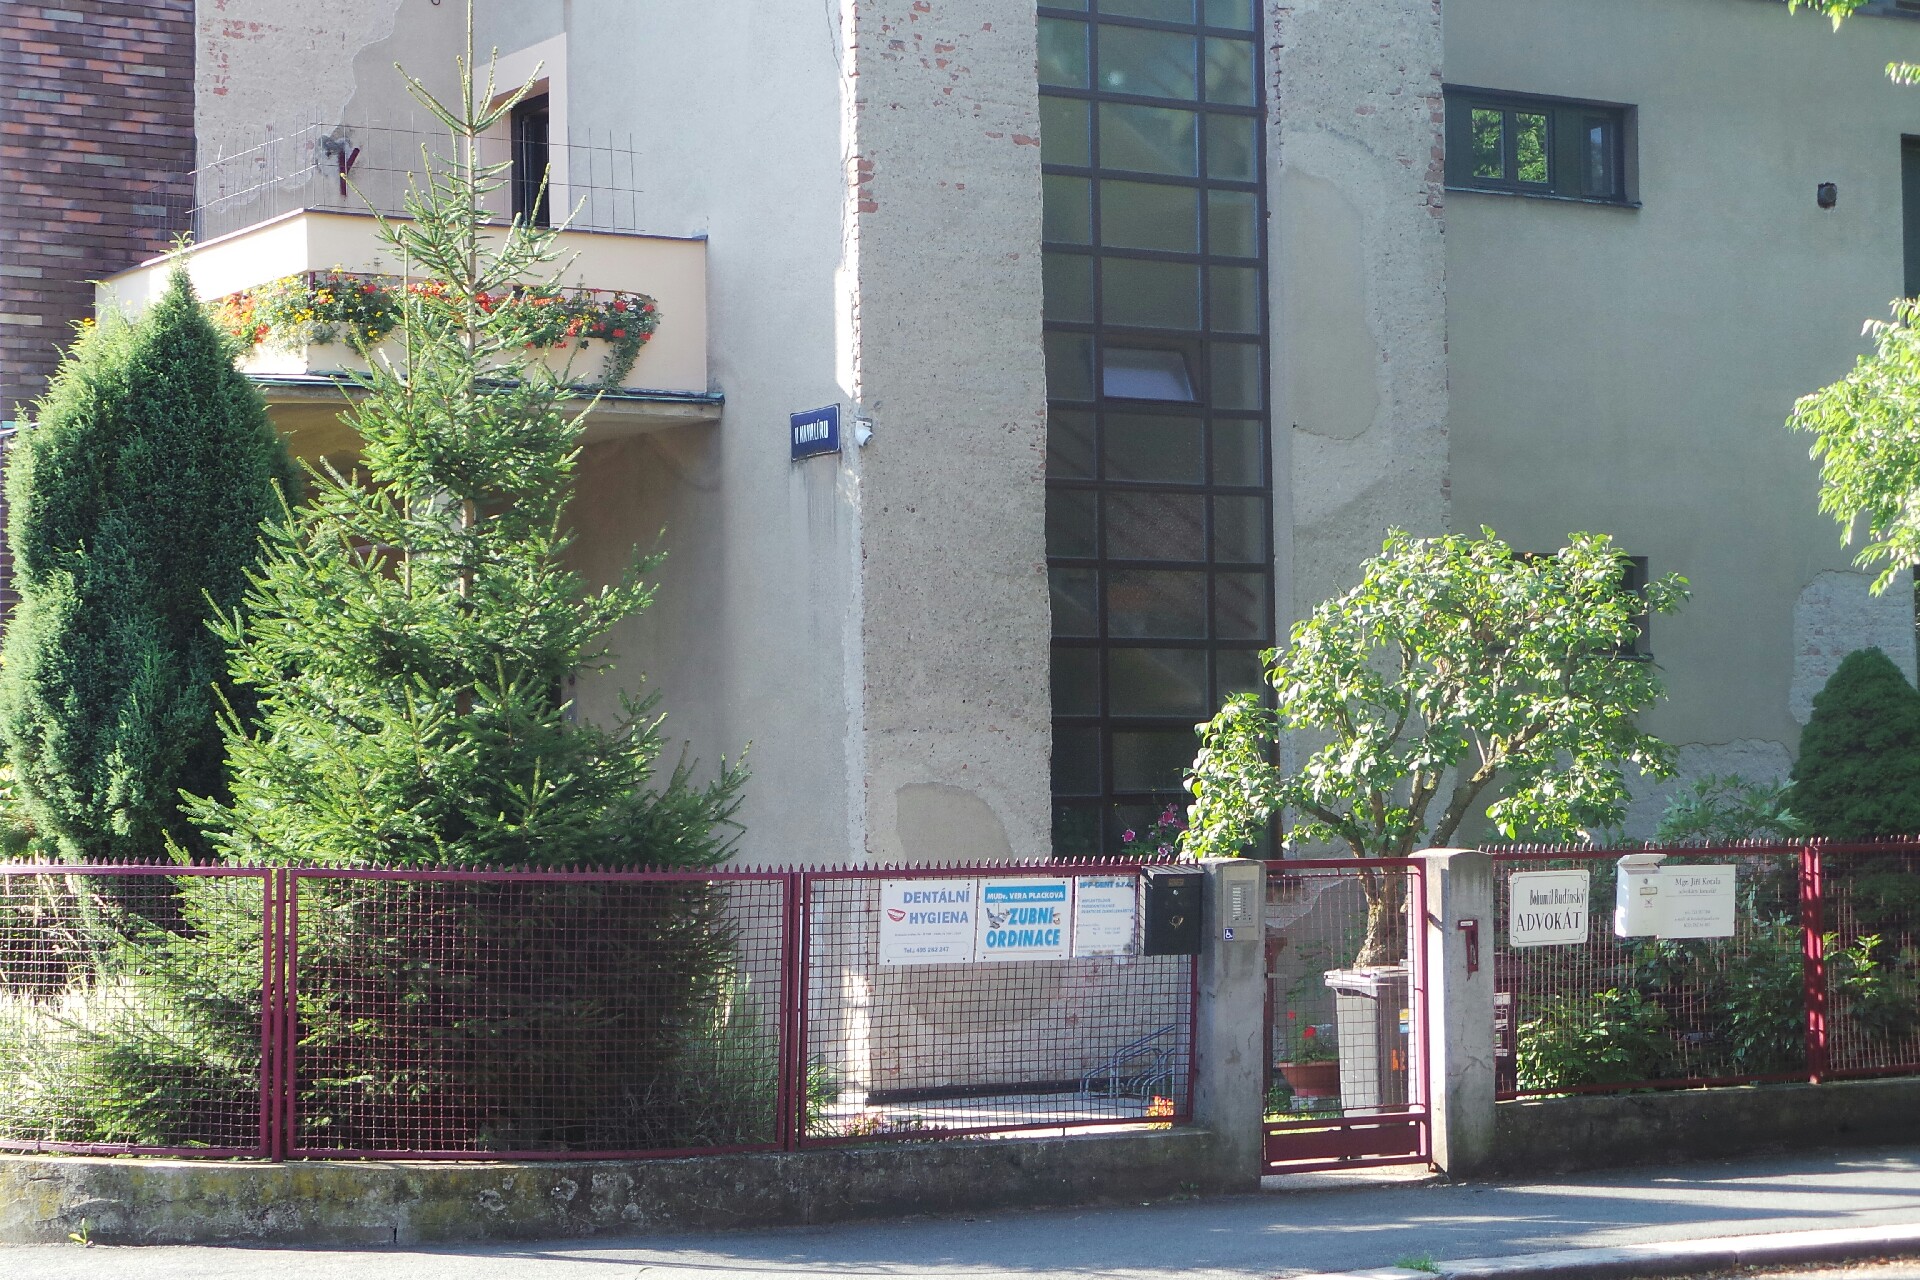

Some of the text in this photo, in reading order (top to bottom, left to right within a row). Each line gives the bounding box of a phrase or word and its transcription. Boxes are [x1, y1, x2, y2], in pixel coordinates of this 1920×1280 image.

[903, 887, 970, 904] DENTÁLNÍ
[1530, 887, 1585, 908] Bohumil Budínský
[909, 910, 969, 925] HYGIENA
[1008, 906, 1055, 925] ZUBNÍ
[1516, 907, 1582, 932] ADVOKÁT
[986, 928, 1061, 948] ORDINACE
